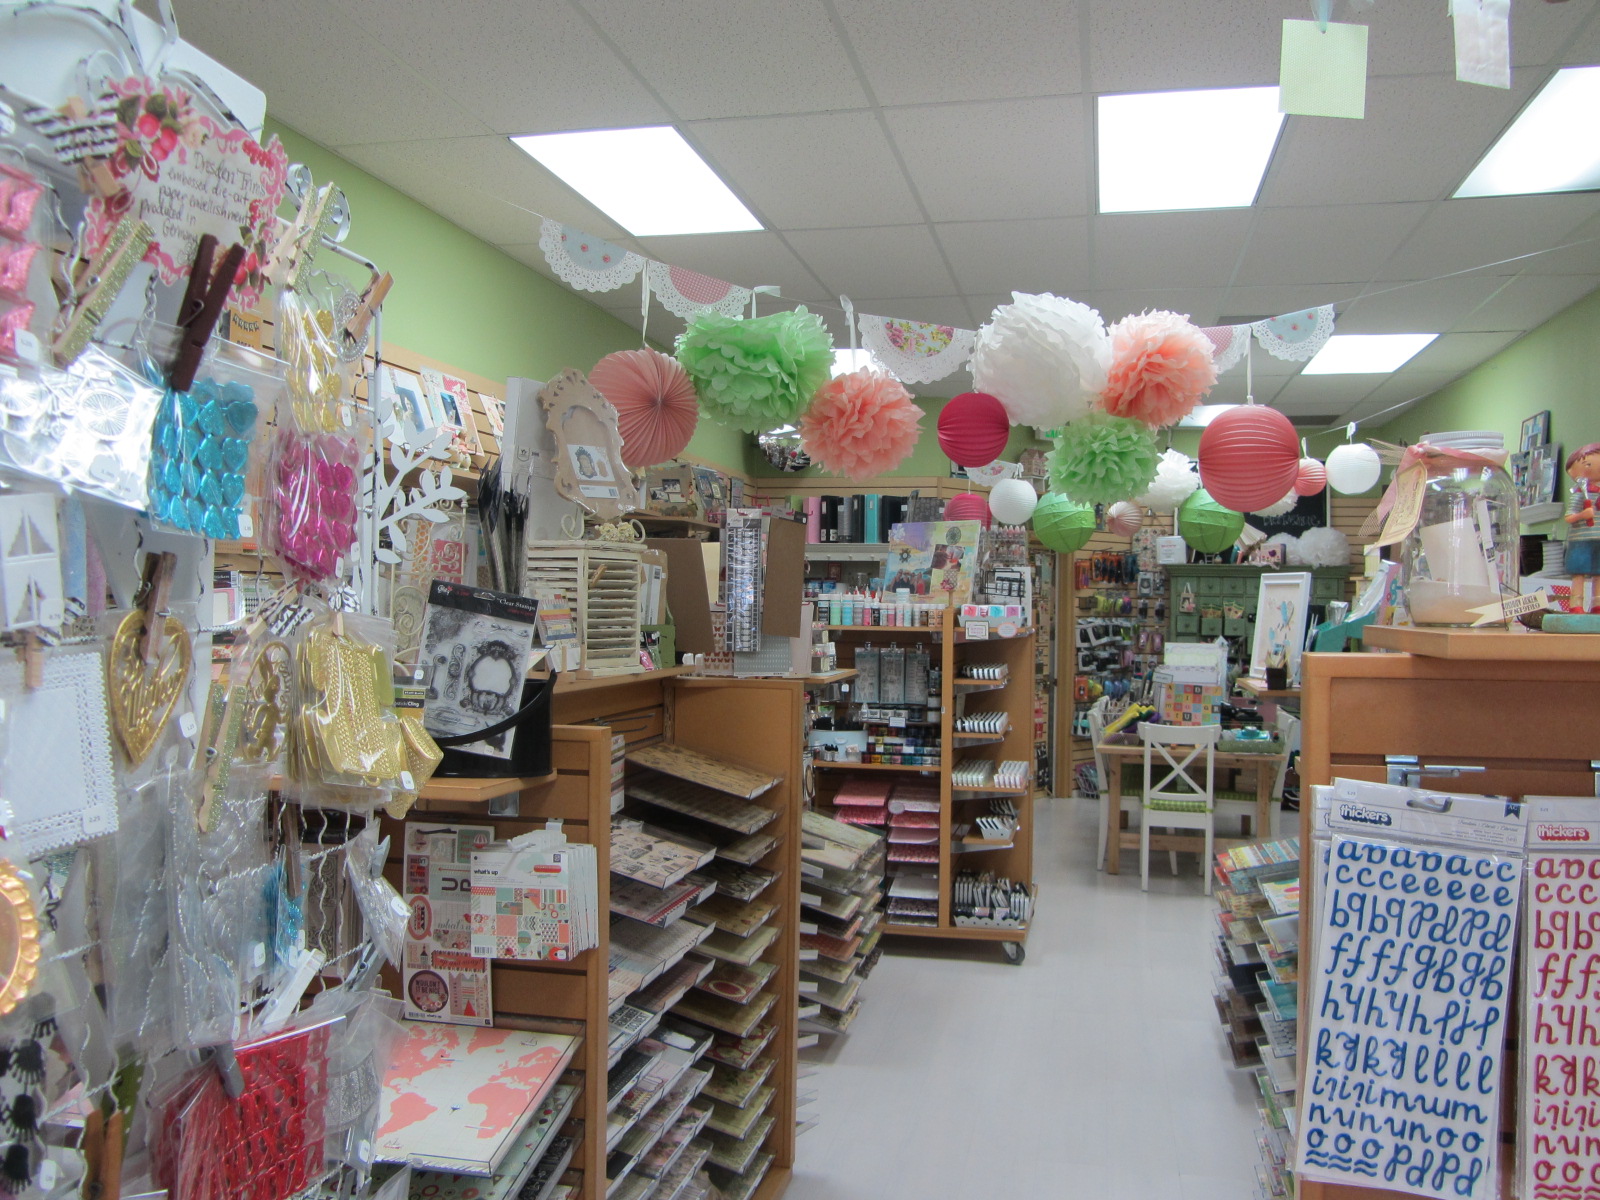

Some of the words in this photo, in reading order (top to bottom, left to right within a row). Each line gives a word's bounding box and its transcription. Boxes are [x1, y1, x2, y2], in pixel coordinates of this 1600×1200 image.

[194, 151, 236, 184] Dresden
[236, 168, 265, 196] Trims
[499, 597, 514, 607] Clear
[515, 601, 536, 611] Stamps
[1339, 803, 1392, 826] thickers
[1536, 824, 1590, 841] thickers
